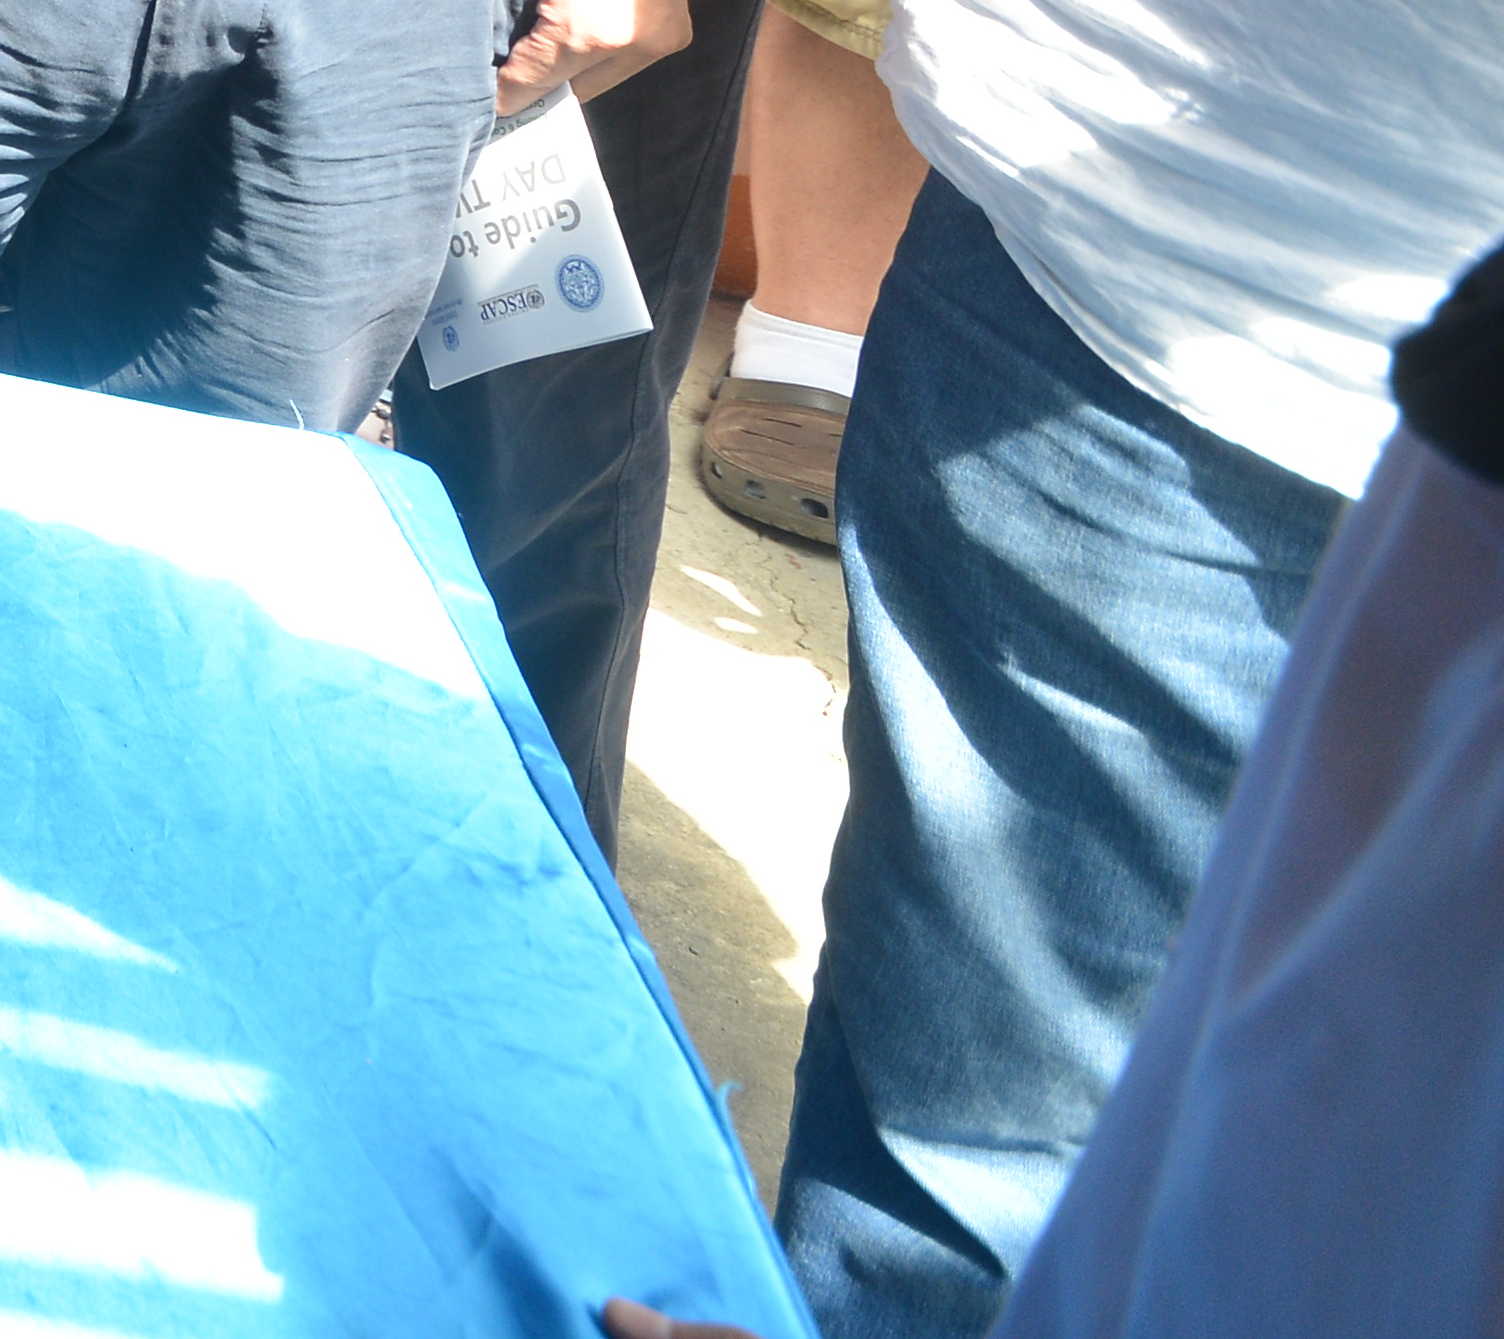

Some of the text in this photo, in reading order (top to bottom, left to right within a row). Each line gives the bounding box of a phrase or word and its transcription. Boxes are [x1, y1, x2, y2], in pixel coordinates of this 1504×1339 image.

[501, 152, 568, 201] DAY
[449, 197, 582, 258] Guide to
[480, 291, 528, 322] ESCAP
